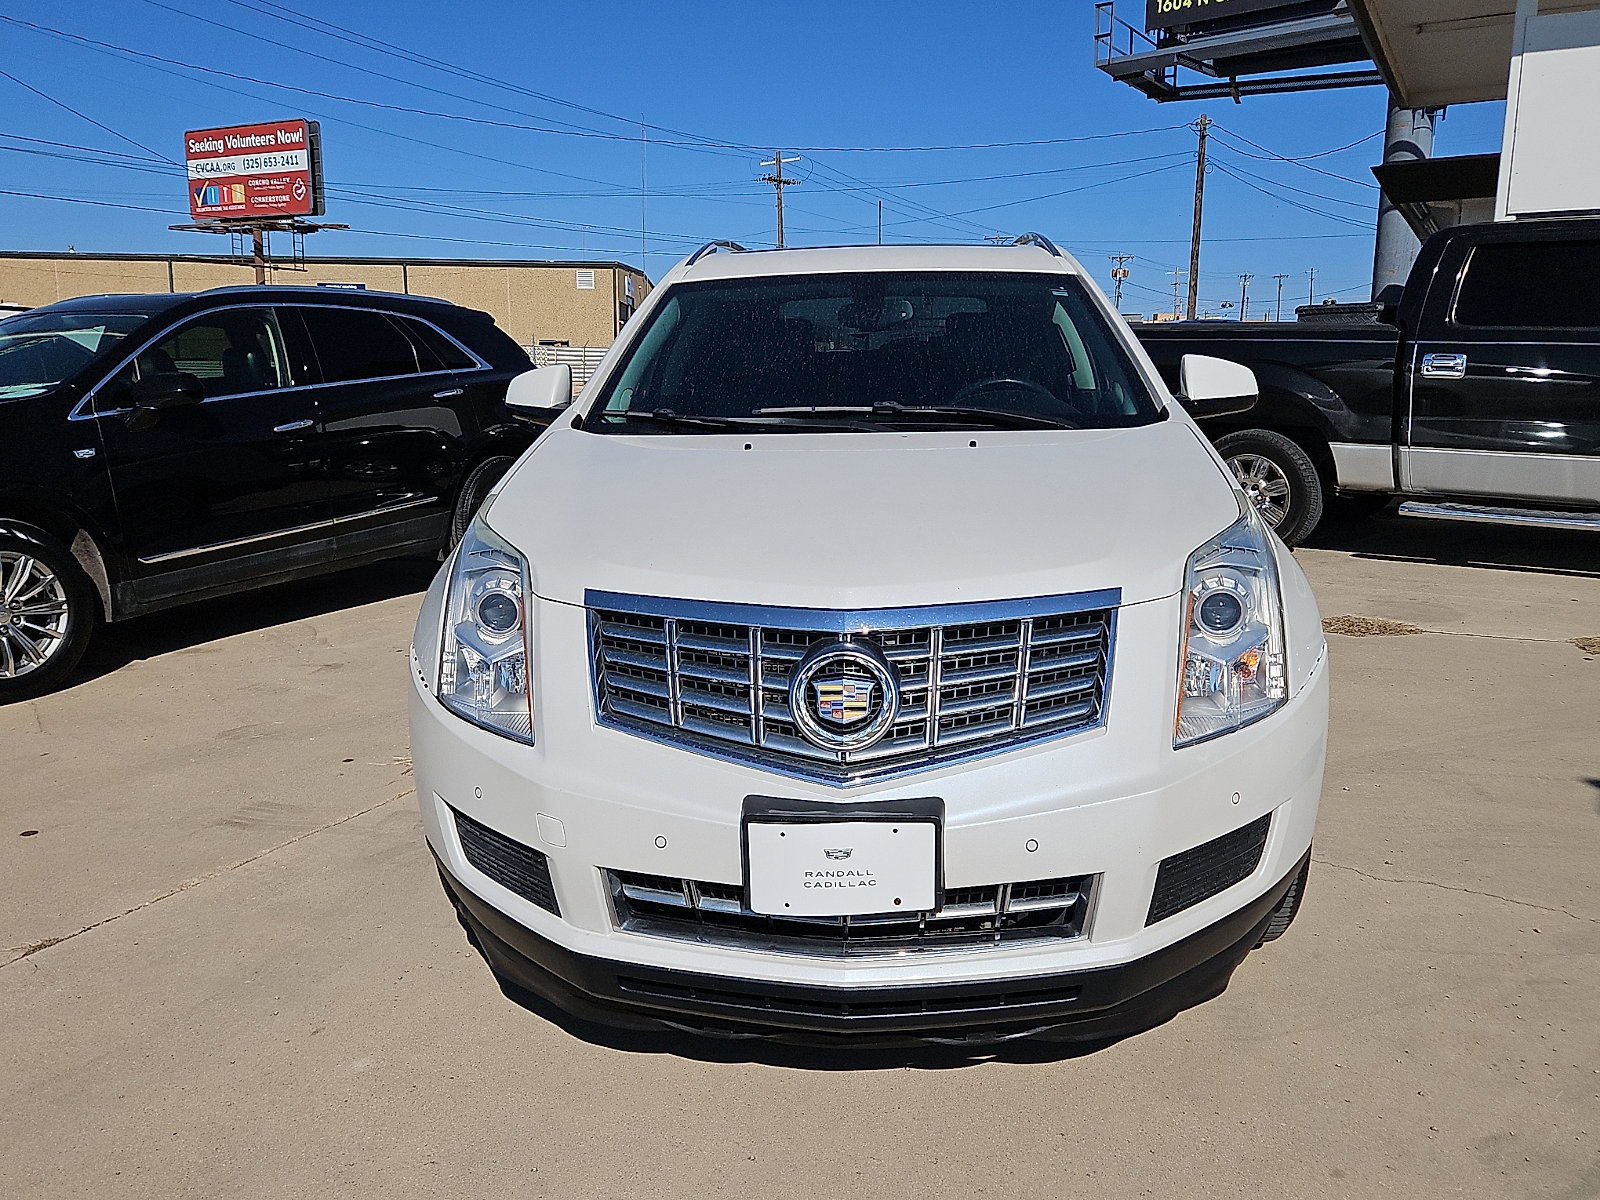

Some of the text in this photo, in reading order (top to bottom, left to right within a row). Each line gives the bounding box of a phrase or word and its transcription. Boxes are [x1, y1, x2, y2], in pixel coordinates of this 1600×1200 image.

[188, 128, 303, 153] Seeking Volunteers Now!
[242, 157, 262, 170] (325)
[263, 154, 299, 168] 653-2411
[804, 870, 874, 878] RANDALL
[803, 879, 877, 889] CADILLAC
